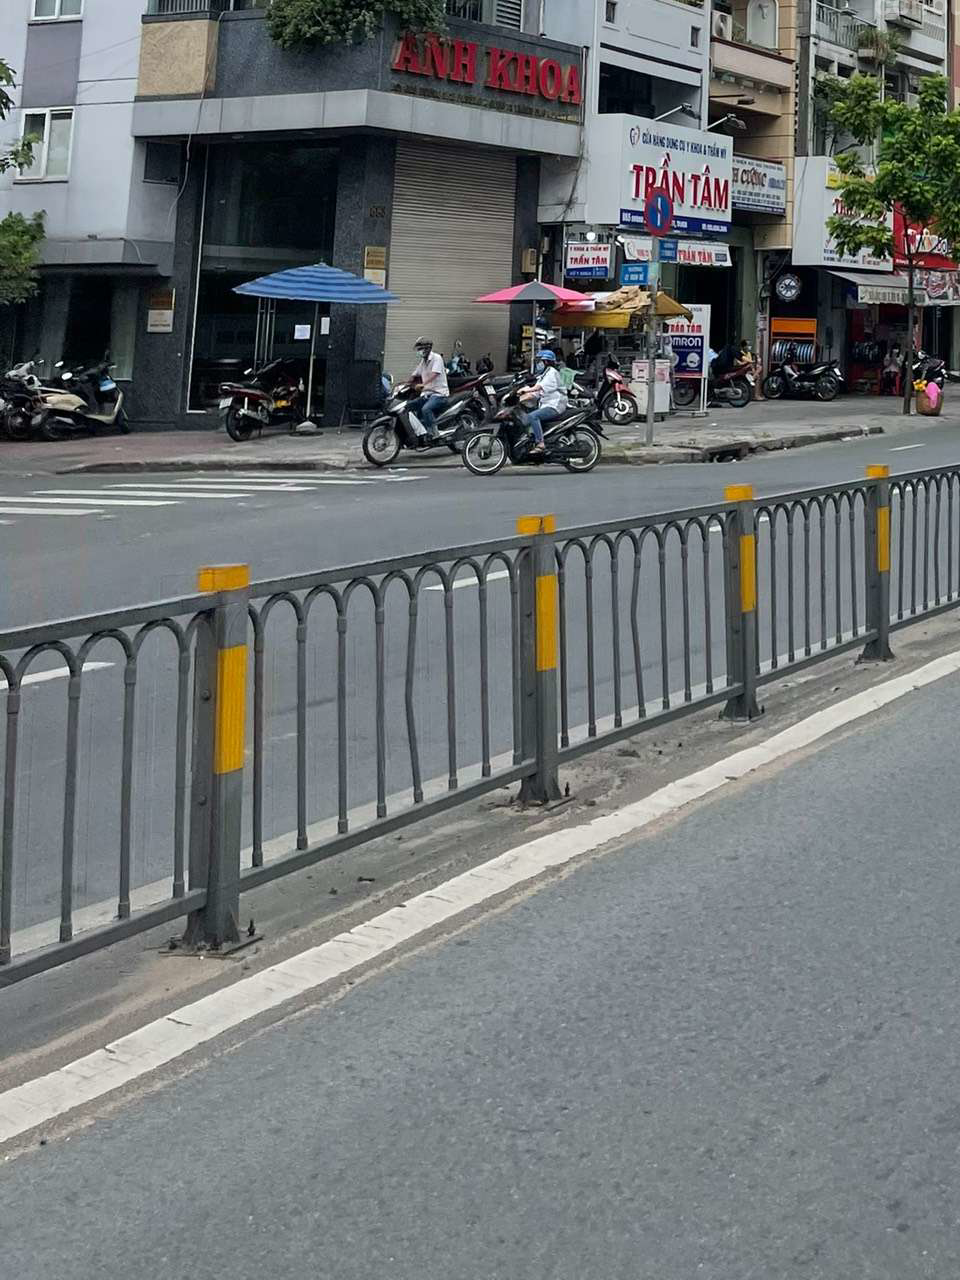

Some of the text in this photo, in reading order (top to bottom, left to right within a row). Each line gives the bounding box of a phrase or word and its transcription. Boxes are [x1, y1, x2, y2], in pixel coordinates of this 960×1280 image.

[391, 31, 479, 85] ANH
[486, 47, 584, 105] KHOA
[690, 164, 729, 210] TÂM
